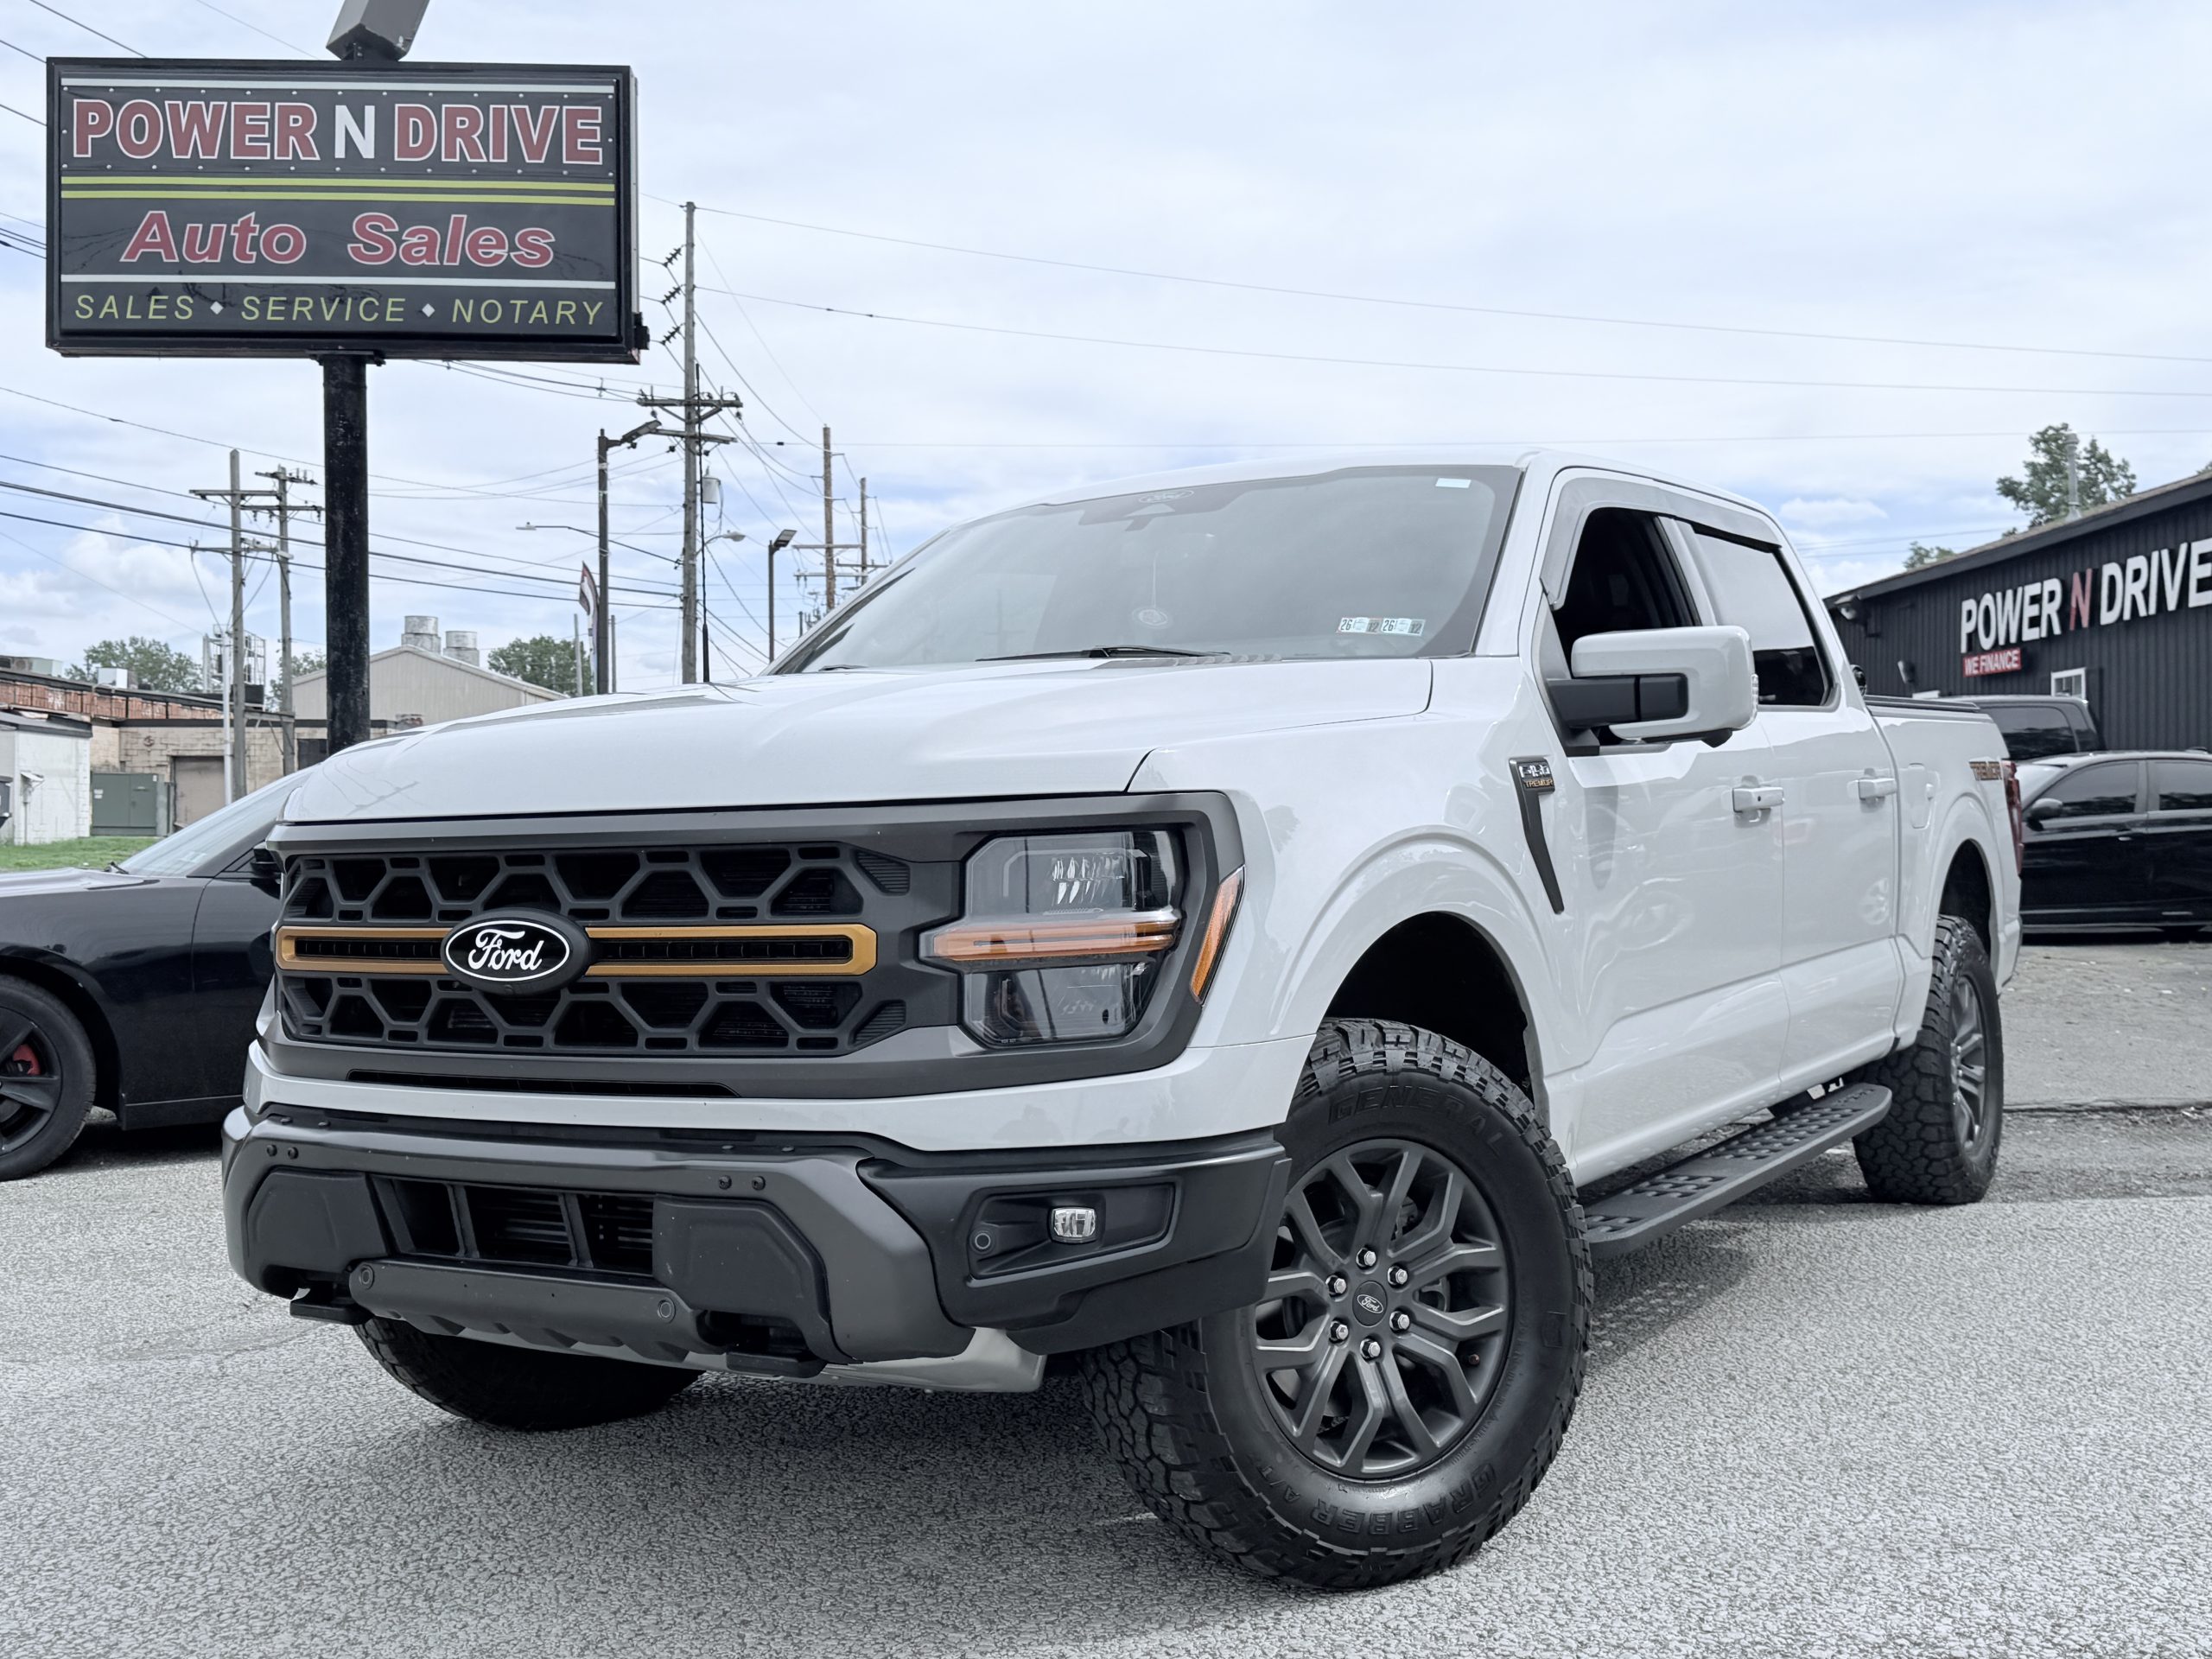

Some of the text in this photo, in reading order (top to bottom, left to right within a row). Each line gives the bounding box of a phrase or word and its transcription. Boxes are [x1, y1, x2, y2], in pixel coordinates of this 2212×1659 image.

[73, 99, 603, 165] POWER N DRIVE
[120, 210, 555, 268] Auto Sales
[75, 295, 603, 326] SALES SERVICE NOTARY
[1961, 538, 2212, 653] POWER N DRIVE
[1340, 619, 1380, 632] 26 12
[1382, 620, 1422, 634] 26 12
[1964, 649, 2019, 677] WE FINANCE
[467, 928, 545, 971] Ford
[1328, 1085, 1505, 1159] GENERAL
[1361, 1296, 1380, 1312] Ford
[1311, 1463, 1496, 1535] GRABBER
